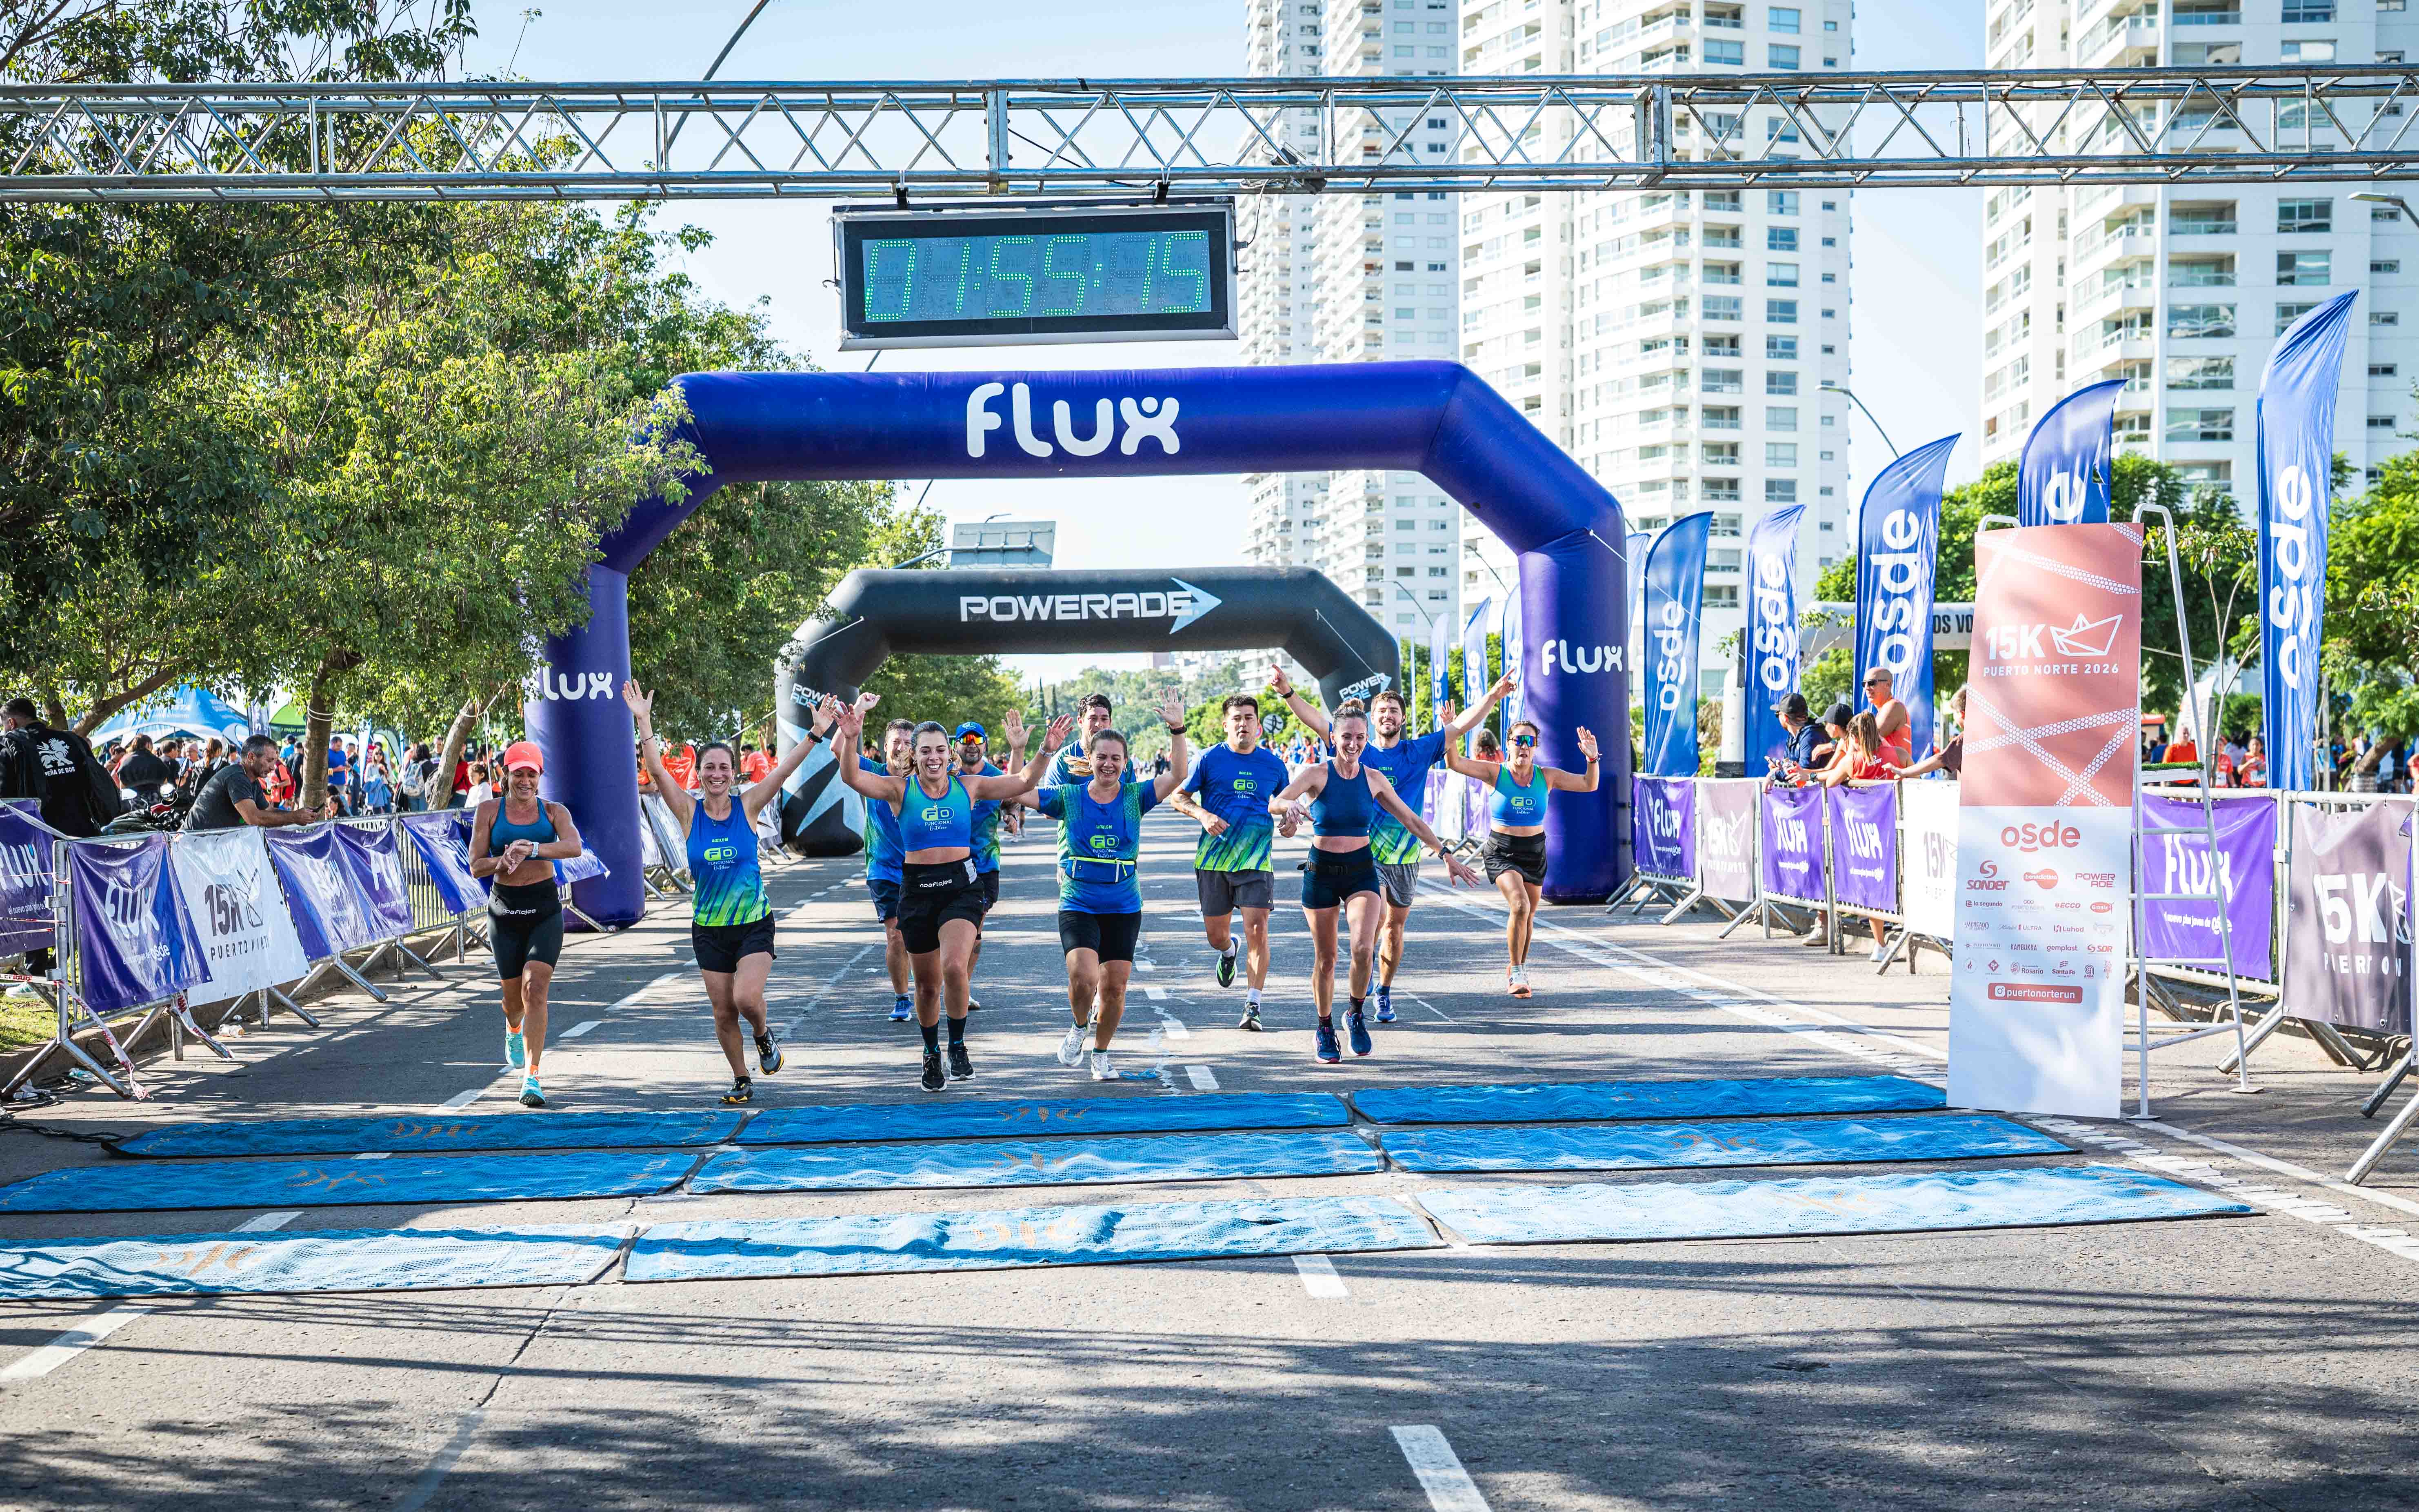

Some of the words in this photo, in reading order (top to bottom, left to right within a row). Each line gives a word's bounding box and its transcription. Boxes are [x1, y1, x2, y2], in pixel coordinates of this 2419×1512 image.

[864, 233, 1206, 320] 01:55:15
[1869, 508, 1923, 675] osde
[2269, 465, 2312, 689] osde
[960, 591, 1192, 622] POWERADE
[1755, 553, 1796, 691] osde
[1655, 602, 1686, 711] osde
[1986, 624, 2046, 660] 15K
[543, 665, 613, 701] lux
[1339, 673, 1384, 699] POWER
[1505, 637, 1523, 719] ode
[1983, 665, 2029, 677] PUERTO
[2034, 664, 2078, 675] NORTE
[2084, 664, 2119, 674] 2026
[2001, 819, 2080, 852] osde
[920, 879, 953, 888] noaflojes
[2211, 916, 2233, 935] ose
[211, 940, 248, 961] PUERTO
[2007, 989, 2075, 999] puertonorterun
